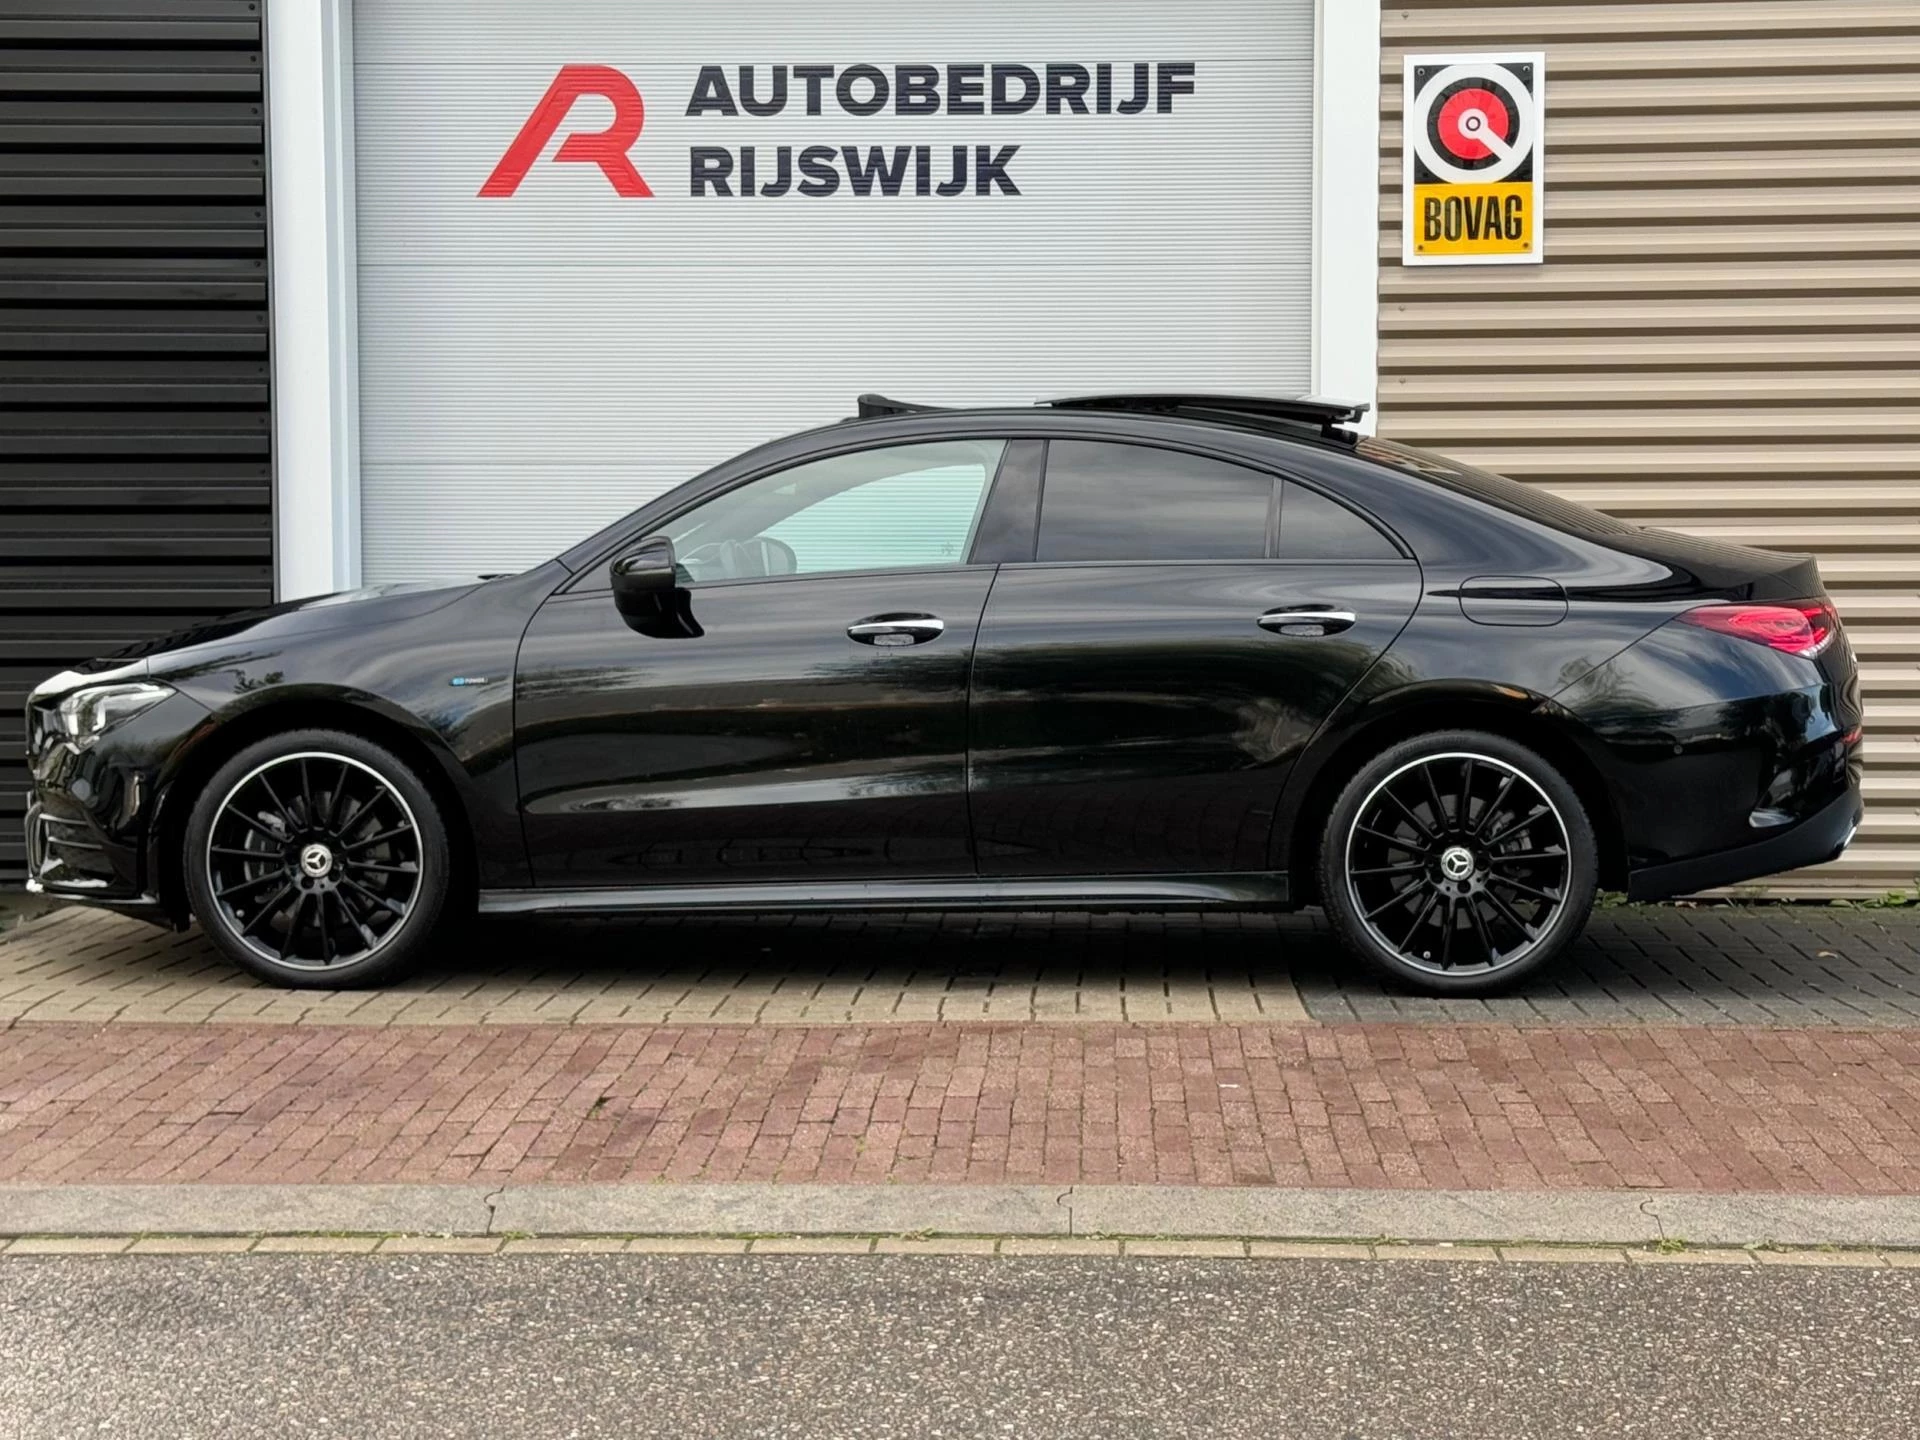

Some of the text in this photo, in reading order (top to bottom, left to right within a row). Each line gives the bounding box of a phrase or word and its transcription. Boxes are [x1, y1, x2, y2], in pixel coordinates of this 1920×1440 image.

[686, 62, 1196, 116] AUTOBEDRIJF
[690, 145, 1021, 197] RIJSWIJK
[1423, 194, 1523, 242] BOVAG
